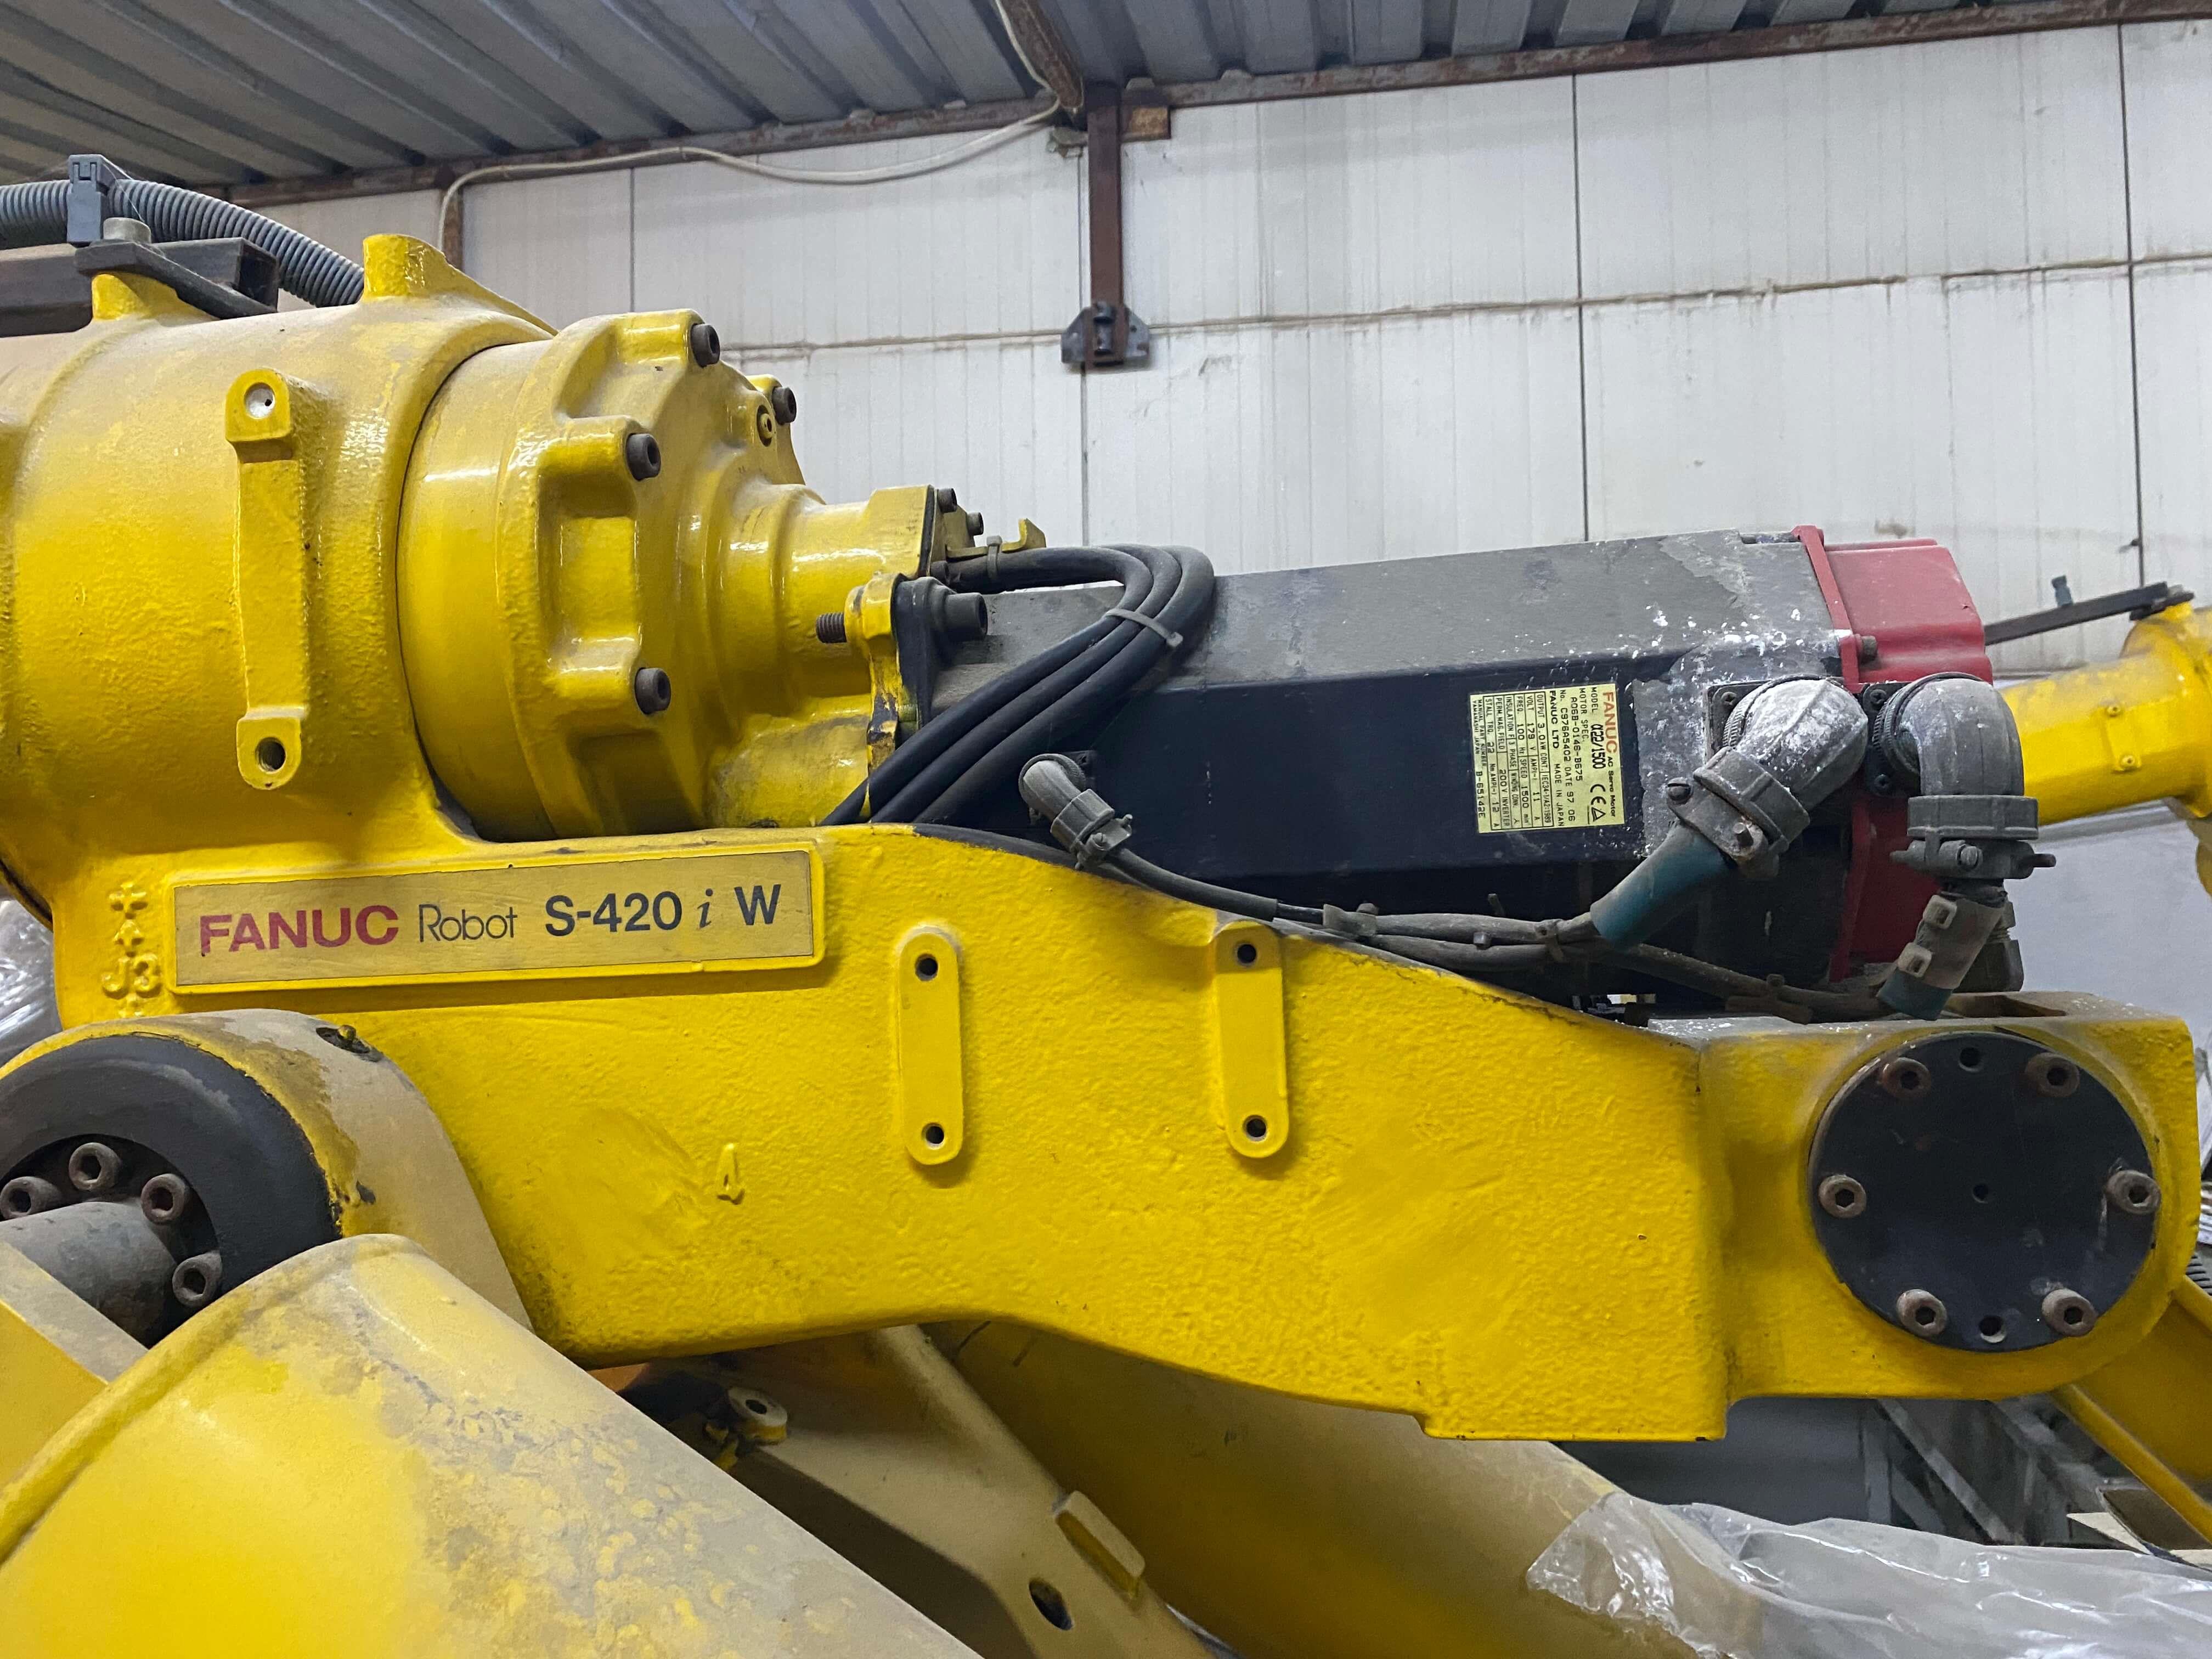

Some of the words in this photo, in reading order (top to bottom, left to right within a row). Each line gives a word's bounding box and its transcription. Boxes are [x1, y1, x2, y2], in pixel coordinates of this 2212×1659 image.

[1506, 697, 1514, 731] INSULATION
[1537, 695, 1545, 718] OUTPUT
[1602, 692, 1617, 753] FANUC
[1561, 708, 1571, 761] C976A5402
[1487, 742, 1494, 753] 22
[1520, 759, 1528, 778] SPEED
[1607, 757, 1613, 767] AC
[1511, 772, 1519, 792] WINDING
[1564, 767, 1572, 786] DATE
[1492, 802, 1499, 812] 12
[1533, 792, 1541, 802] 11
[200, 904, 399, 953] FANUC
[418, 904, 518, 943] Robot
[545, 889, 682, 936] S-420
[696, 888, 714, 929] i
[733, 883, 782, 926] W
[101, 952, 162, 1000] J3
